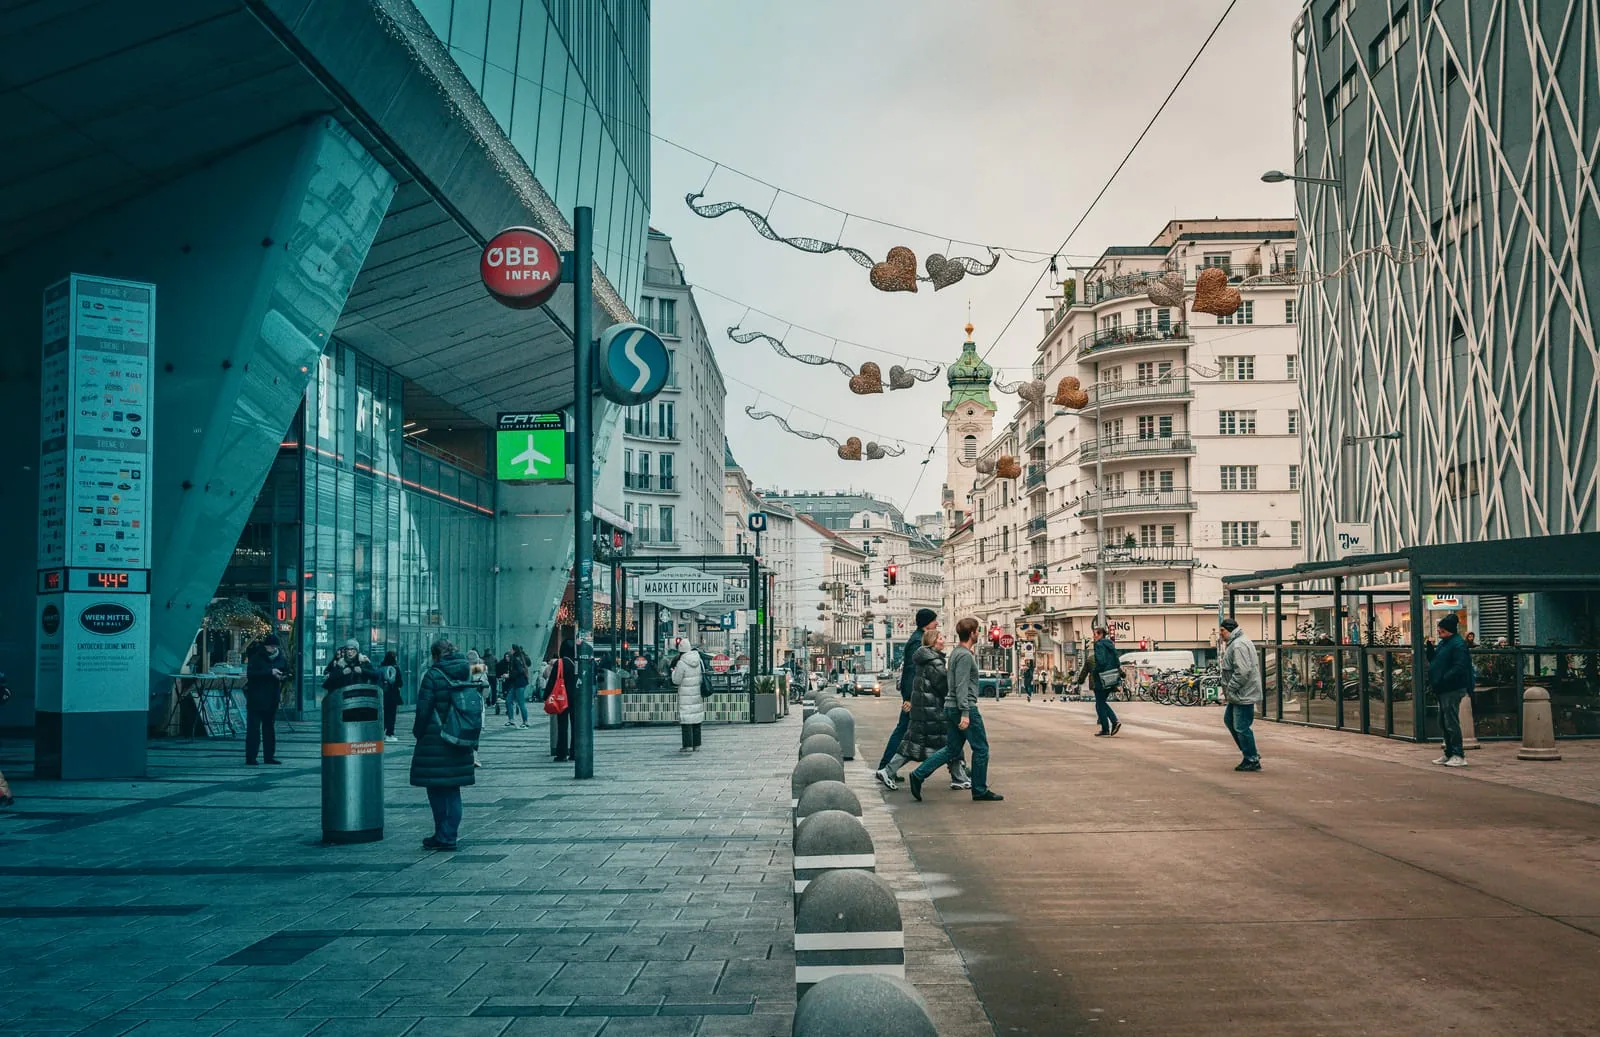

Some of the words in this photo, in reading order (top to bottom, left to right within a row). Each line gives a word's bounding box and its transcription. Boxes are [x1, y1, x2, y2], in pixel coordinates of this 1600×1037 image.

[487, 246, 539, 267] ÖBB
[505, 270, 551, 281] INFRA
[644, 582, 679, 593] MARKET
[682, 582, 719, 593] KITCHEN
[1031, 585, 1069, 595] APOTHEKE
[1001, 637, 1013, 645] STOP
[1206, 687, 1215, 699] P
